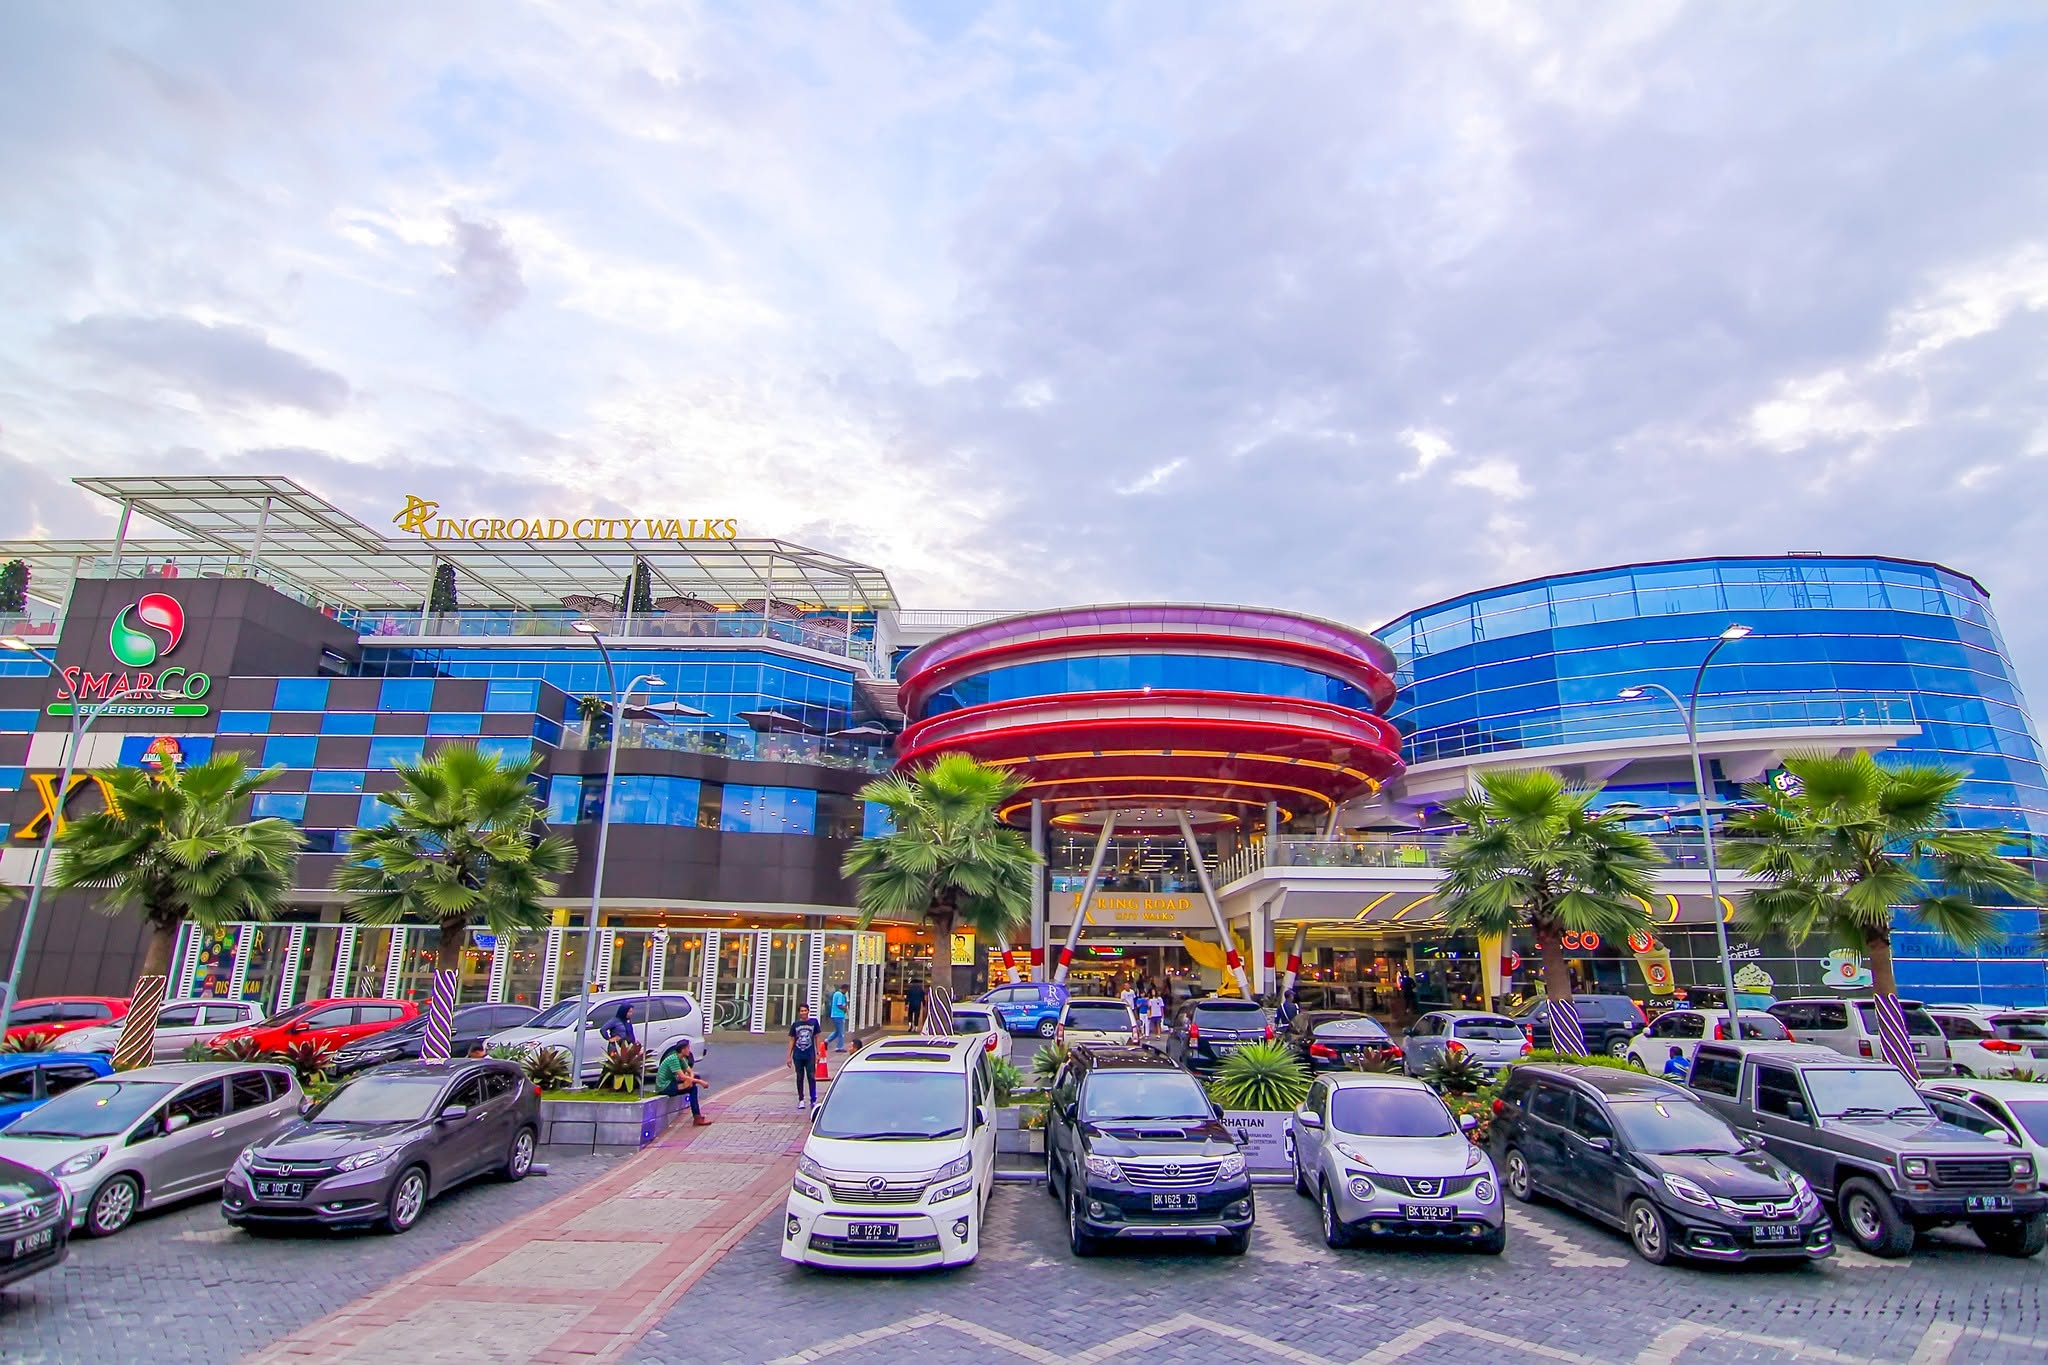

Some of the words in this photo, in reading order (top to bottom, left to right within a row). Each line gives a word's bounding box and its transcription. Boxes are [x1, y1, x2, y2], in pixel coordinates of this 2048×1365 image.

[393, 494, 569, 540] RINGROAD
[572, 518, 639, 540] CITY
[644, 518, 738, 540] WALKS
[79, 705, 176, 715] SUPERSTORE
[1098, 898, 1139, 911] RING
[1143, 898, 1191, 911] ROAD
[1115, 912, 1139, 920] CITY
[1142, 912, 1176, 921] WALKS
[1221, 1118, 1265, 1127] RHATIAN
[259, 1183, 269, 1193] BK
[272, 1183, 289, 1193] 1057
[1154, 1194, 1163, 1205] BK
[1164, 1194, 1181, 1204] 1625
[1187, 1194, 1197, 1204] ZR
[1408, 1205, 1420, 1216] BK
[1420, 1206, 1438, 1217] 1212
[1438, 1207, 1450, 1217] UP
[850, 1225, 860, 1236] BK
[864, 1225, 882, 1236] 1273
[886, 1225, 897, 1236] JV
[1755, 1225, 1765, 1236] BK
[1768, 1225, 1785, 1236] 1040
[1789, 1225, 1798, 1235] YS
